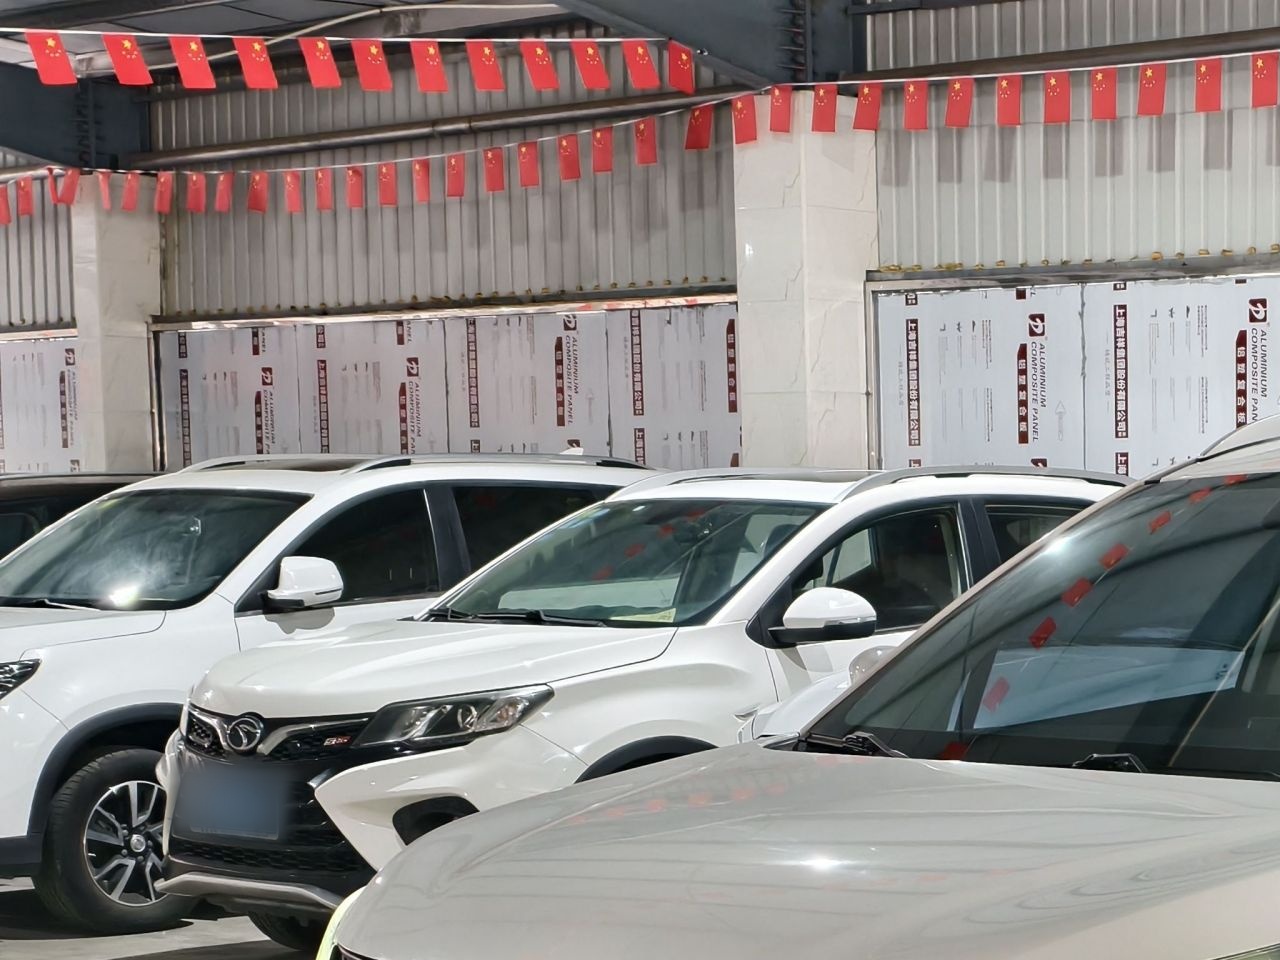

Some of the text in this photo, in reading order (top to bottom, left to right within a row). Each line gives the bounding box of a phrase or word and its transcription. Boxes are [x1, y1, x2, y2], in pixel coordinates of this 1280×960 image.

[1030, 341, 1040, 443] COMPOSITE PANEL
[1039, 343, 1047, 408] ALUMINIUM
[1251, 327, 1260, 394] COMPOSITE
[1260, 329, 1268, 397] ALUMINIUM
